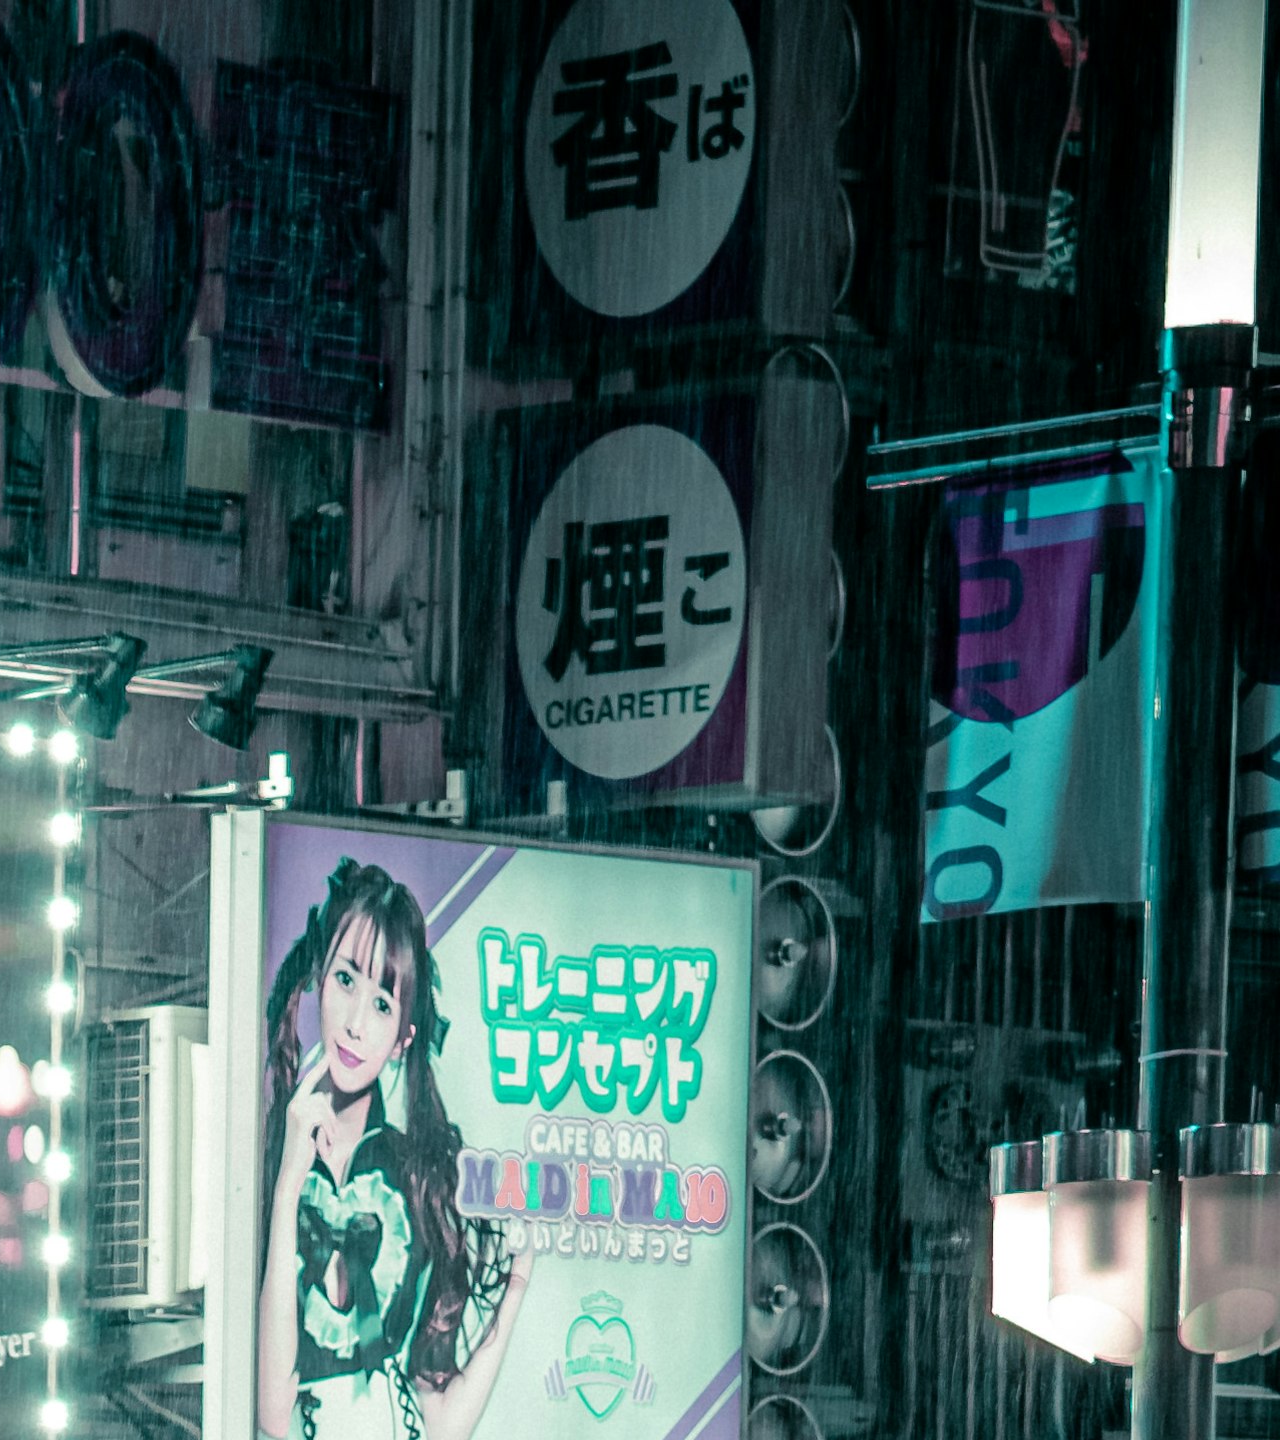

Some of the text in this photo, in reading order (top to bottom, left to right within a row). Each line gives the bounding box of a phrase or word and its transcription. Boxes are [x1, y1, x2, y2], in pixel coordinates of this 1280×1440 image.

[551, 41, 678, 221] 香
[686, 73, 749, 163] ば
[544, 515, 671, 684] 煙
[545, 684, 711, 731] CIGARETTE
[482, 935, 713, 1032] トレーニング
[493, 1026, 698, 1110] コンセプト
[530, 1123, 664, 1162] CAFE & BAR
[461, 1156, 567, 1211] MAID
[574, 1163, 612, 1217] in
